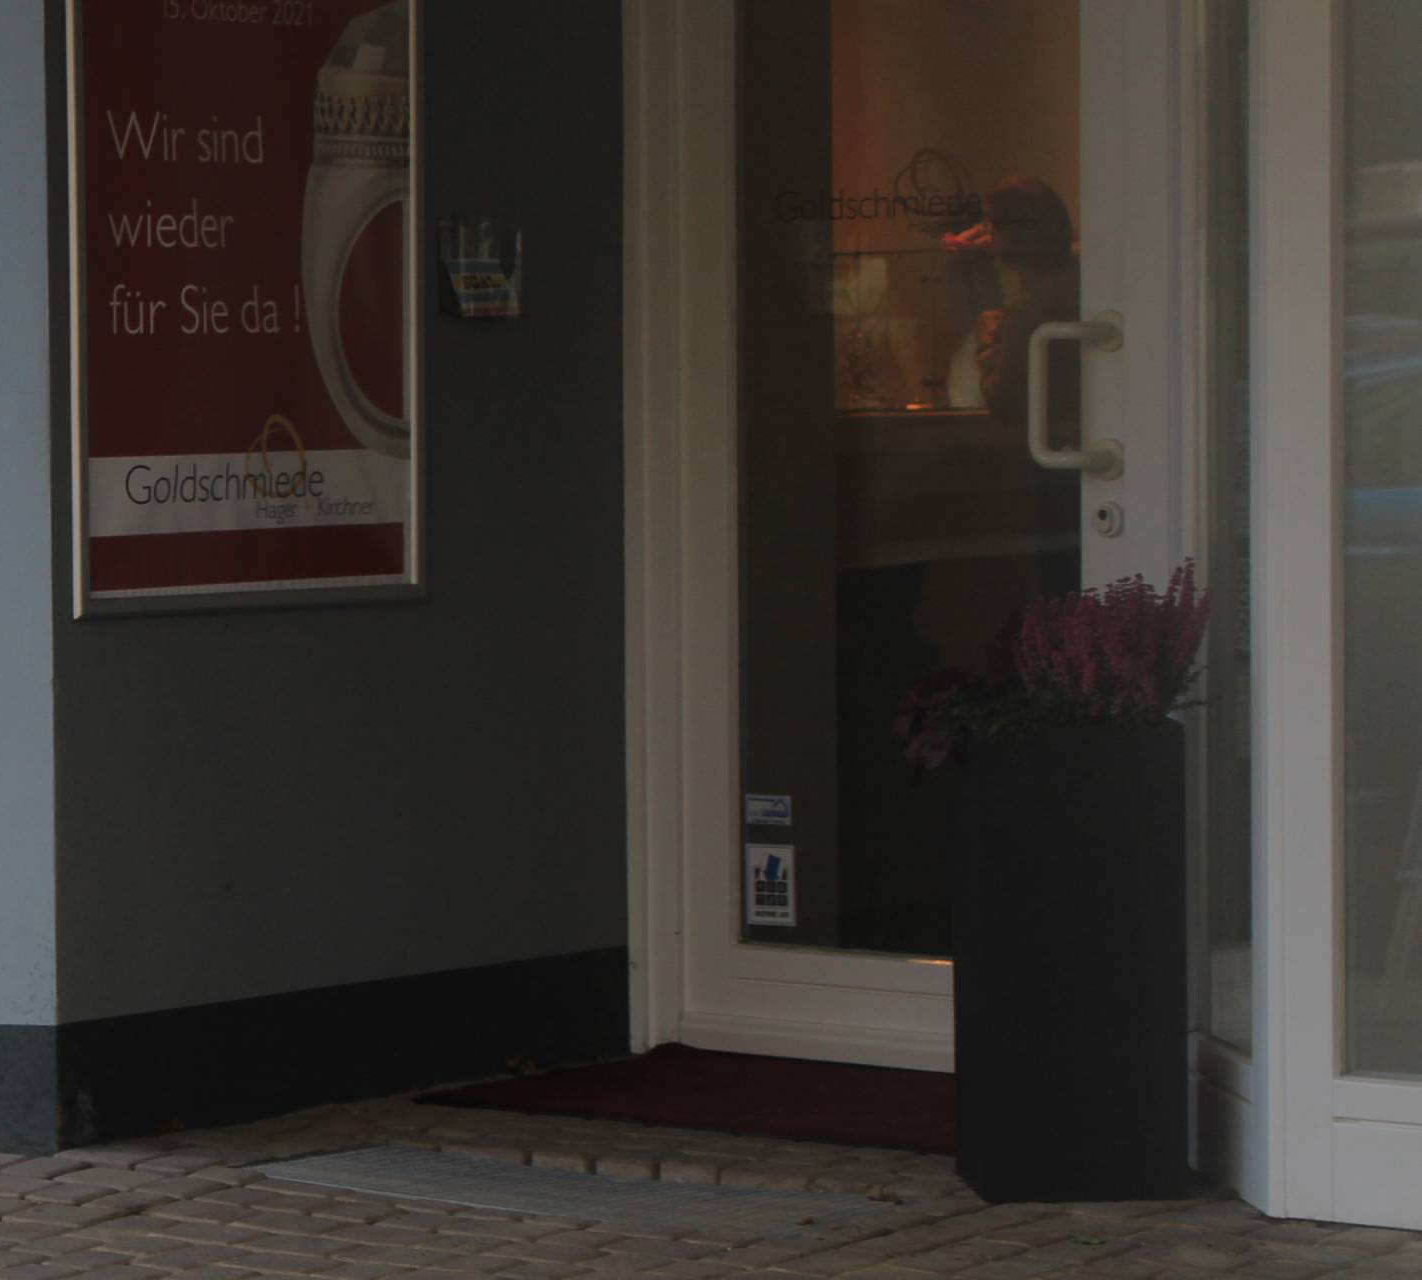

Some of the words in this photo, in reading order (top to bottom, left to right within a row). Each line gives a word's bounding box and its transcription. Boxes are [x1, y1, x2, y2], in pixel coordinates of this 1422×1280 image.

[191, 0, 266, 23] Oktober
[272, 0, 314, 28] 2021
[107, 109, 185, 162] Wir
[197, 114, 264, 164] sind
[108, 198, 234, 249] wieder
[109, 284, 167, 335] für
[180, 284, 230, 335] Sie
[241, 284, 280, 335] da
[125, 462, 325, 505] Goldschmiede
[256, 500, 297, 525] Hager
[317, 498, 375, 517] Kirchner
